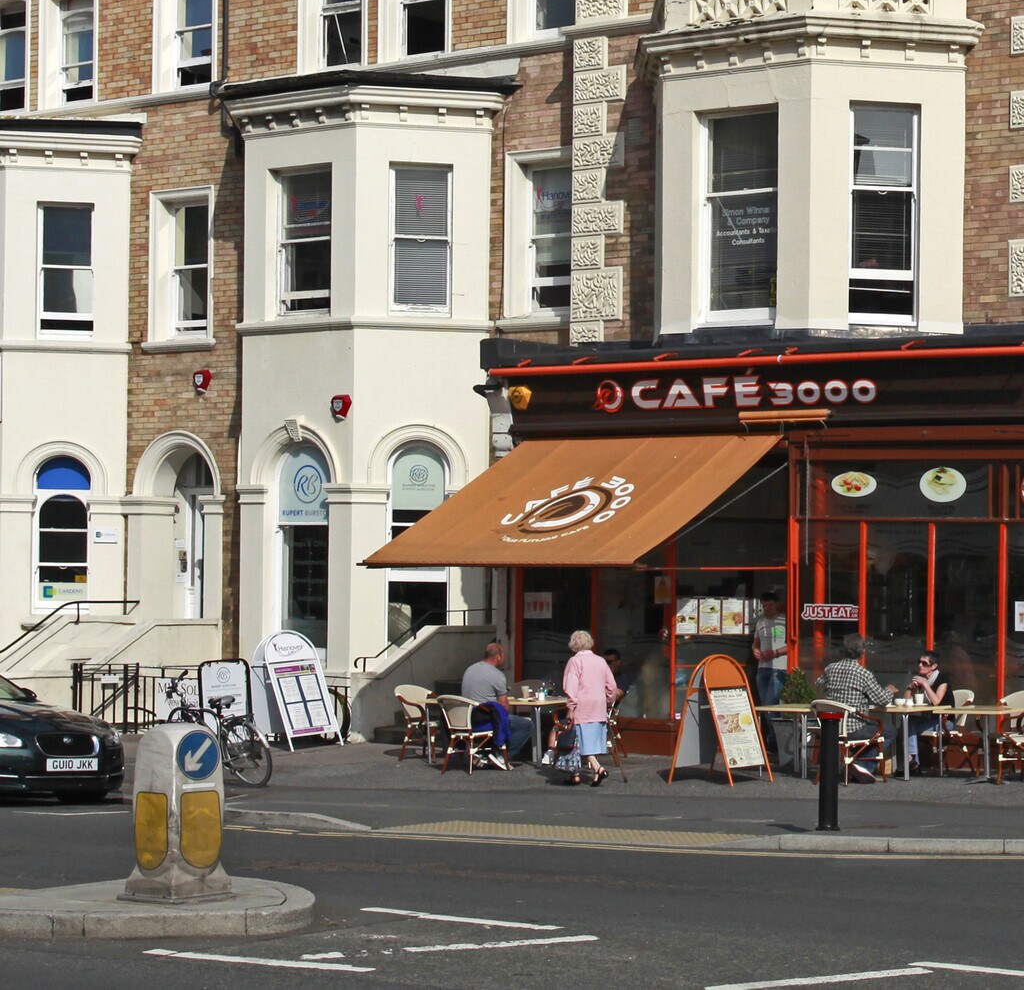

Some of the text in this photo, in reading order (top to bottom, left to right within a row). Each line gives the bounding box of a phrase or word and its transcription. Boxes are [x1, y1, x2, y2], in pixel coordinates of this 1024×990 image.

[736, 217, 770, 225] Company
[630, 367, 878, 409] CAFÉ 3000
[804, 606, 852, 618] JUST EAT
[52, 760, 93, 770] GU10 JKK
